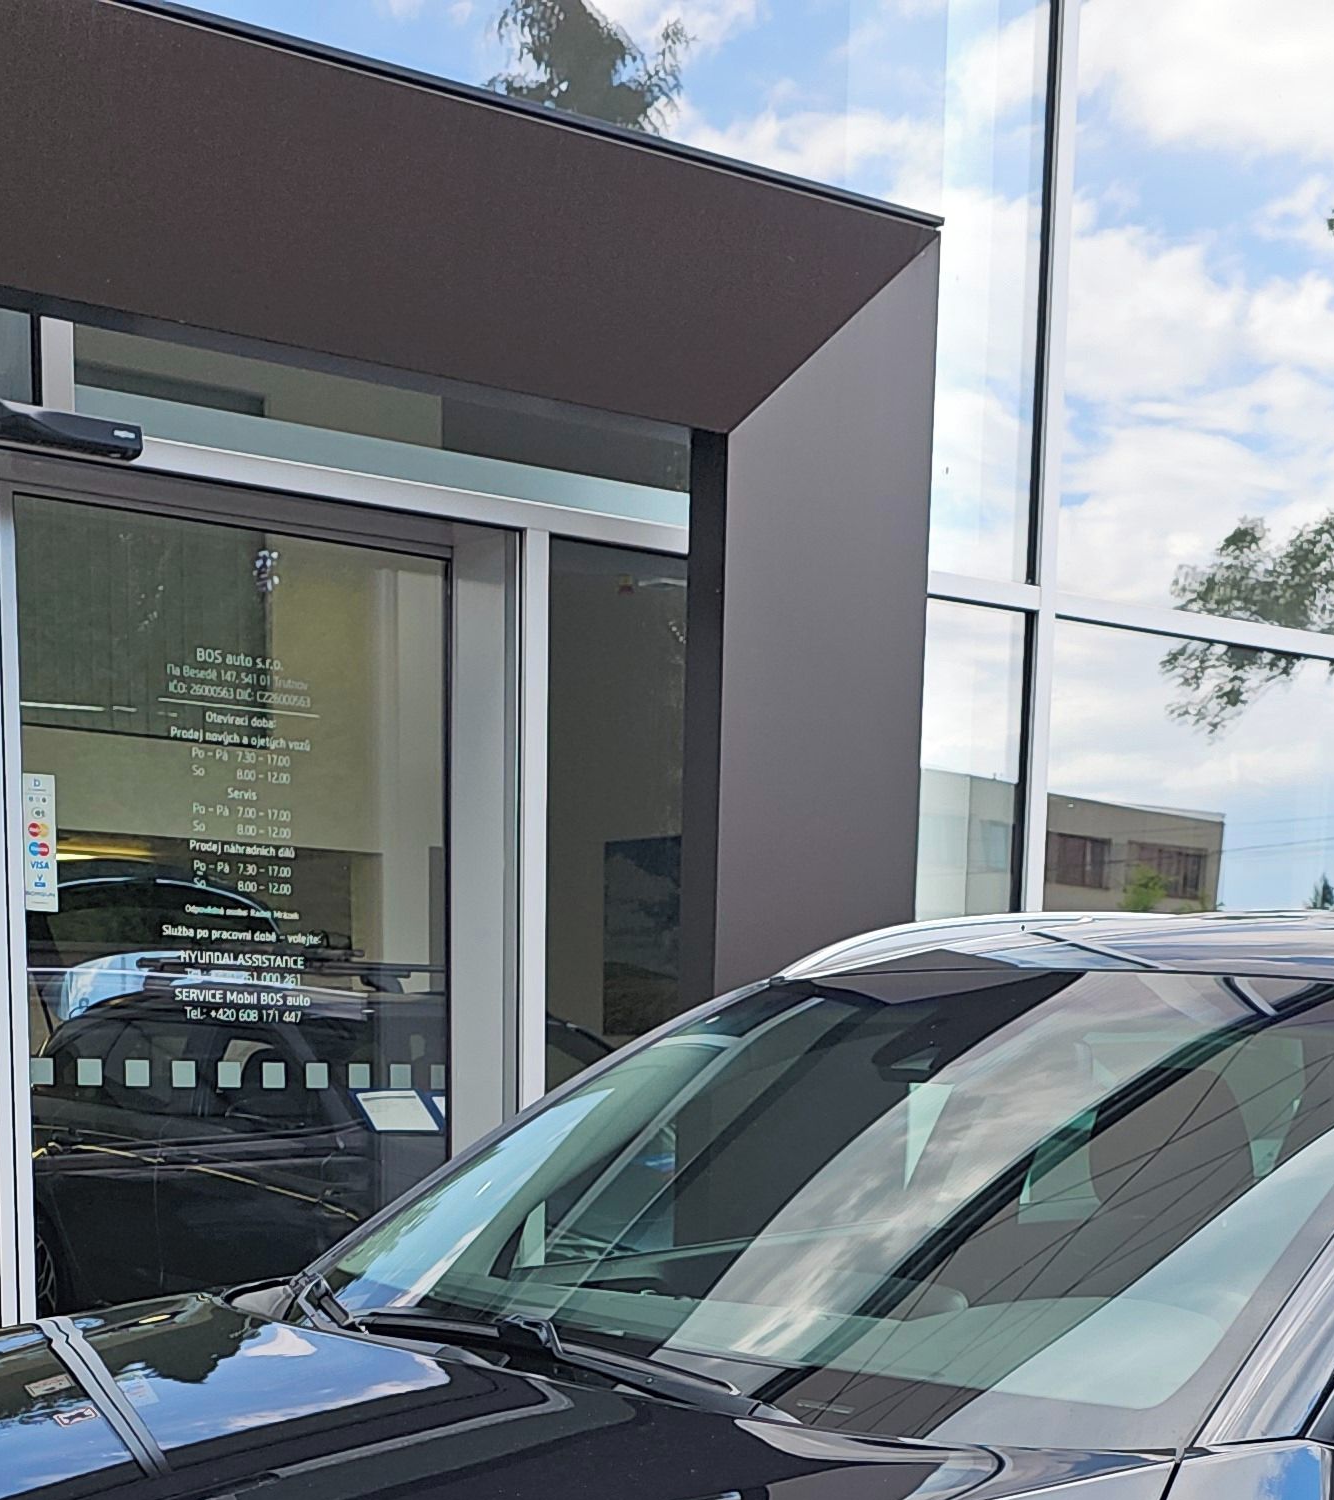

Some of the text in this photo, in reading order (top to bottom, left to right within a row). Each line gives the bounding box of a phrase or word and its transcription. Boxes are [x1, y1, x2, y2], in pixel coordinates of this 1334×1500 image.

[196, 648, 284, 671] BOS auto s.r.o.
[167, 664, 180, 677] Na
[241, 672, 257, 685] 541
[170, 726, 204, 742] Prodej
[205, 731, 240, 746] nových
[242, 737, 249, 745] a
[251, 737, 286, 750] ojetých
[191, 747, 205, 759] Po
[216, 750, 229, 762] Pá
[237, 751, 256, 764] 7.30
[267, 755, 291, 767] 17.00
[191, 765, 205, 776] So
[236, 768, 256, 781] 8.00
[267, 772, 291, 784] 12.00
[227, 787, 257, 800] Servis
[192, 803, 205, 815] Po
[216, 805, 229, 817] Pá
[237, 806, 256, 819] 7.00
[268, 809, 291, 822] 17.00
[192, 820, 205, 832] So
[237, 824, 257, 836] 8.00
[268, 827, 291, 839] 12.00
[189, 840, 221, 855] Prodej
[223, 842, 275, 858] náhradních
[30, 860, 49, 869] VISA
[193, 860, 206, 872] Po
[217, 862, 230, 874] Pá
[237, 863, 257, 876] 7.30
[268, 865, 291, 878] 17.00
[237, 881, 257, 893] 8.00
[268, 883, 291, 895] 12.00
[162, 924, 194, 938] Služba
[196, 929, 209, 940] po
[253, 931, 276, 943] době
[174, 988, 311, 1007] SERVICE Mobil BOS auto
[210, 1008, 236, 1021] +420
[239, 1009, 259, 1022] 608
[262, 1009, 279, 1022] 171
[282, 1011, 302, 1024] 447
